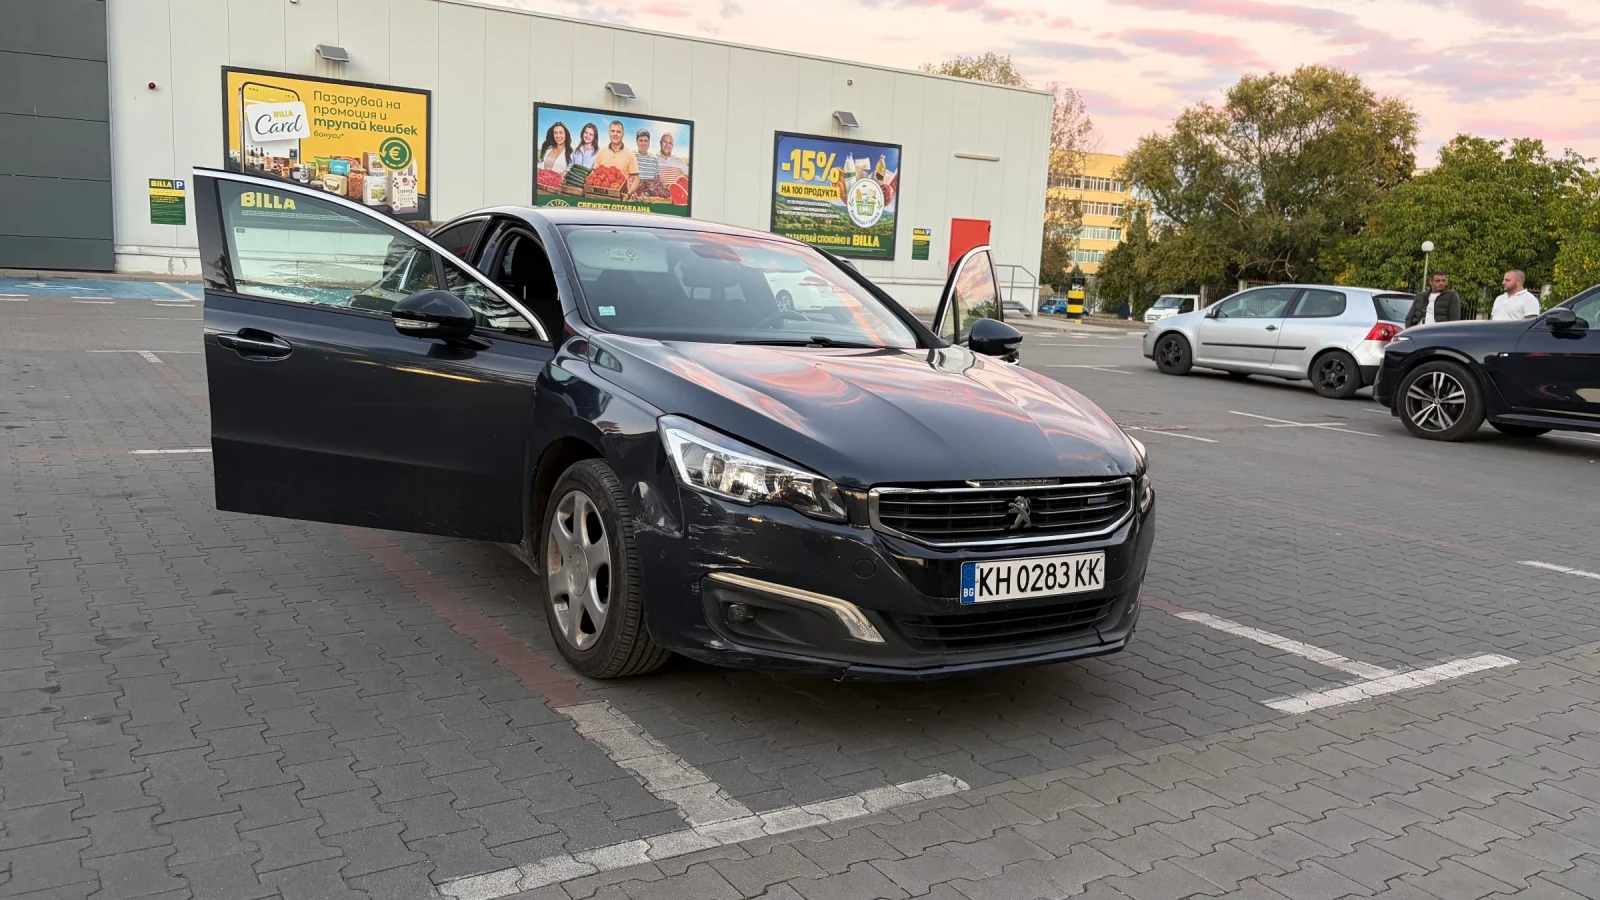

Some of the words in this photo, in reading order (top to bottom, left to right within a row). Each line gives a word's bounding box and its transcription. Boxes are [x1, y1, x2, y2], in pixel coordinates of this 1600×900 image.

[313, 90, 383, 108] Пазарувай
[386, 101, 401, 110] на
[273, 110, 294, 118] BILLA
[313, 105, 377, 120] промоция
[380, 113, 387, 121] и
[255, 113, 303, 135] Card
[313, 117, 367, 131] трупай
[369, 121, 418, 136] кешбек
[781, 148, 840, 183] -15%
[151, 180, 172, 188] BILLA
[781, 185, 791, 193] НА
[792, 186, 804, 195] 100
[805, 188, 838, 198] ПРОДУКТА
[240, 191, 296, 210] BILLA
[577, 201, 610, 209] СВЕЖЕСТ
[817, 234, 846, 245] СПОКОЙНО
[853, 235, 880, 247] BILLA
[979, 566, 1011, 596] KH
[1017, 562, 1070, 593] 0283
[1075, 558, 1100, 587] KK
[963, 588, 974, 598] BG
